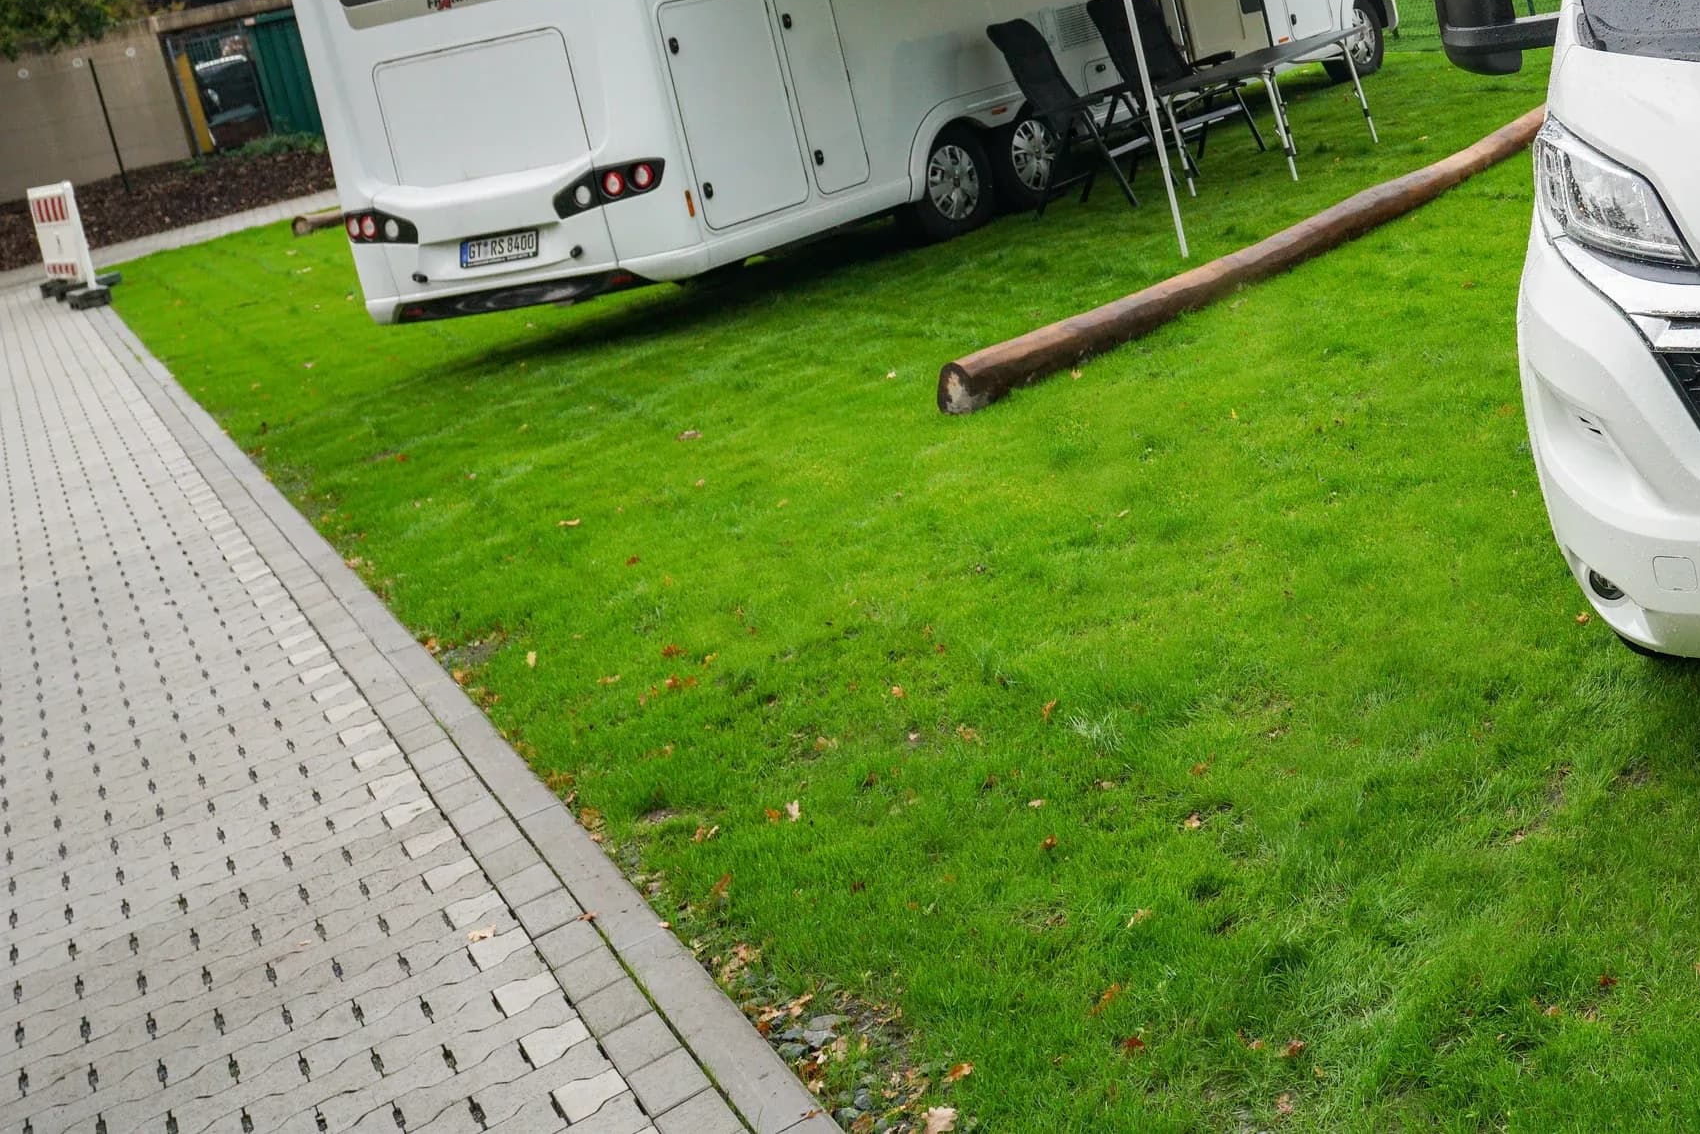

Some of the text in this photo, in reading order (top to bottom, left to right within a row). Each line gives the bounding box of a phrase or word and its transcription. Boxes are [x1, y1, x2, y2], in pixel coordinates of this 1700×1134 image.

[468, 241, 482, 260] GT
[490, 238, 505, 257] RS
[507, 233, 534, 253] 8400
